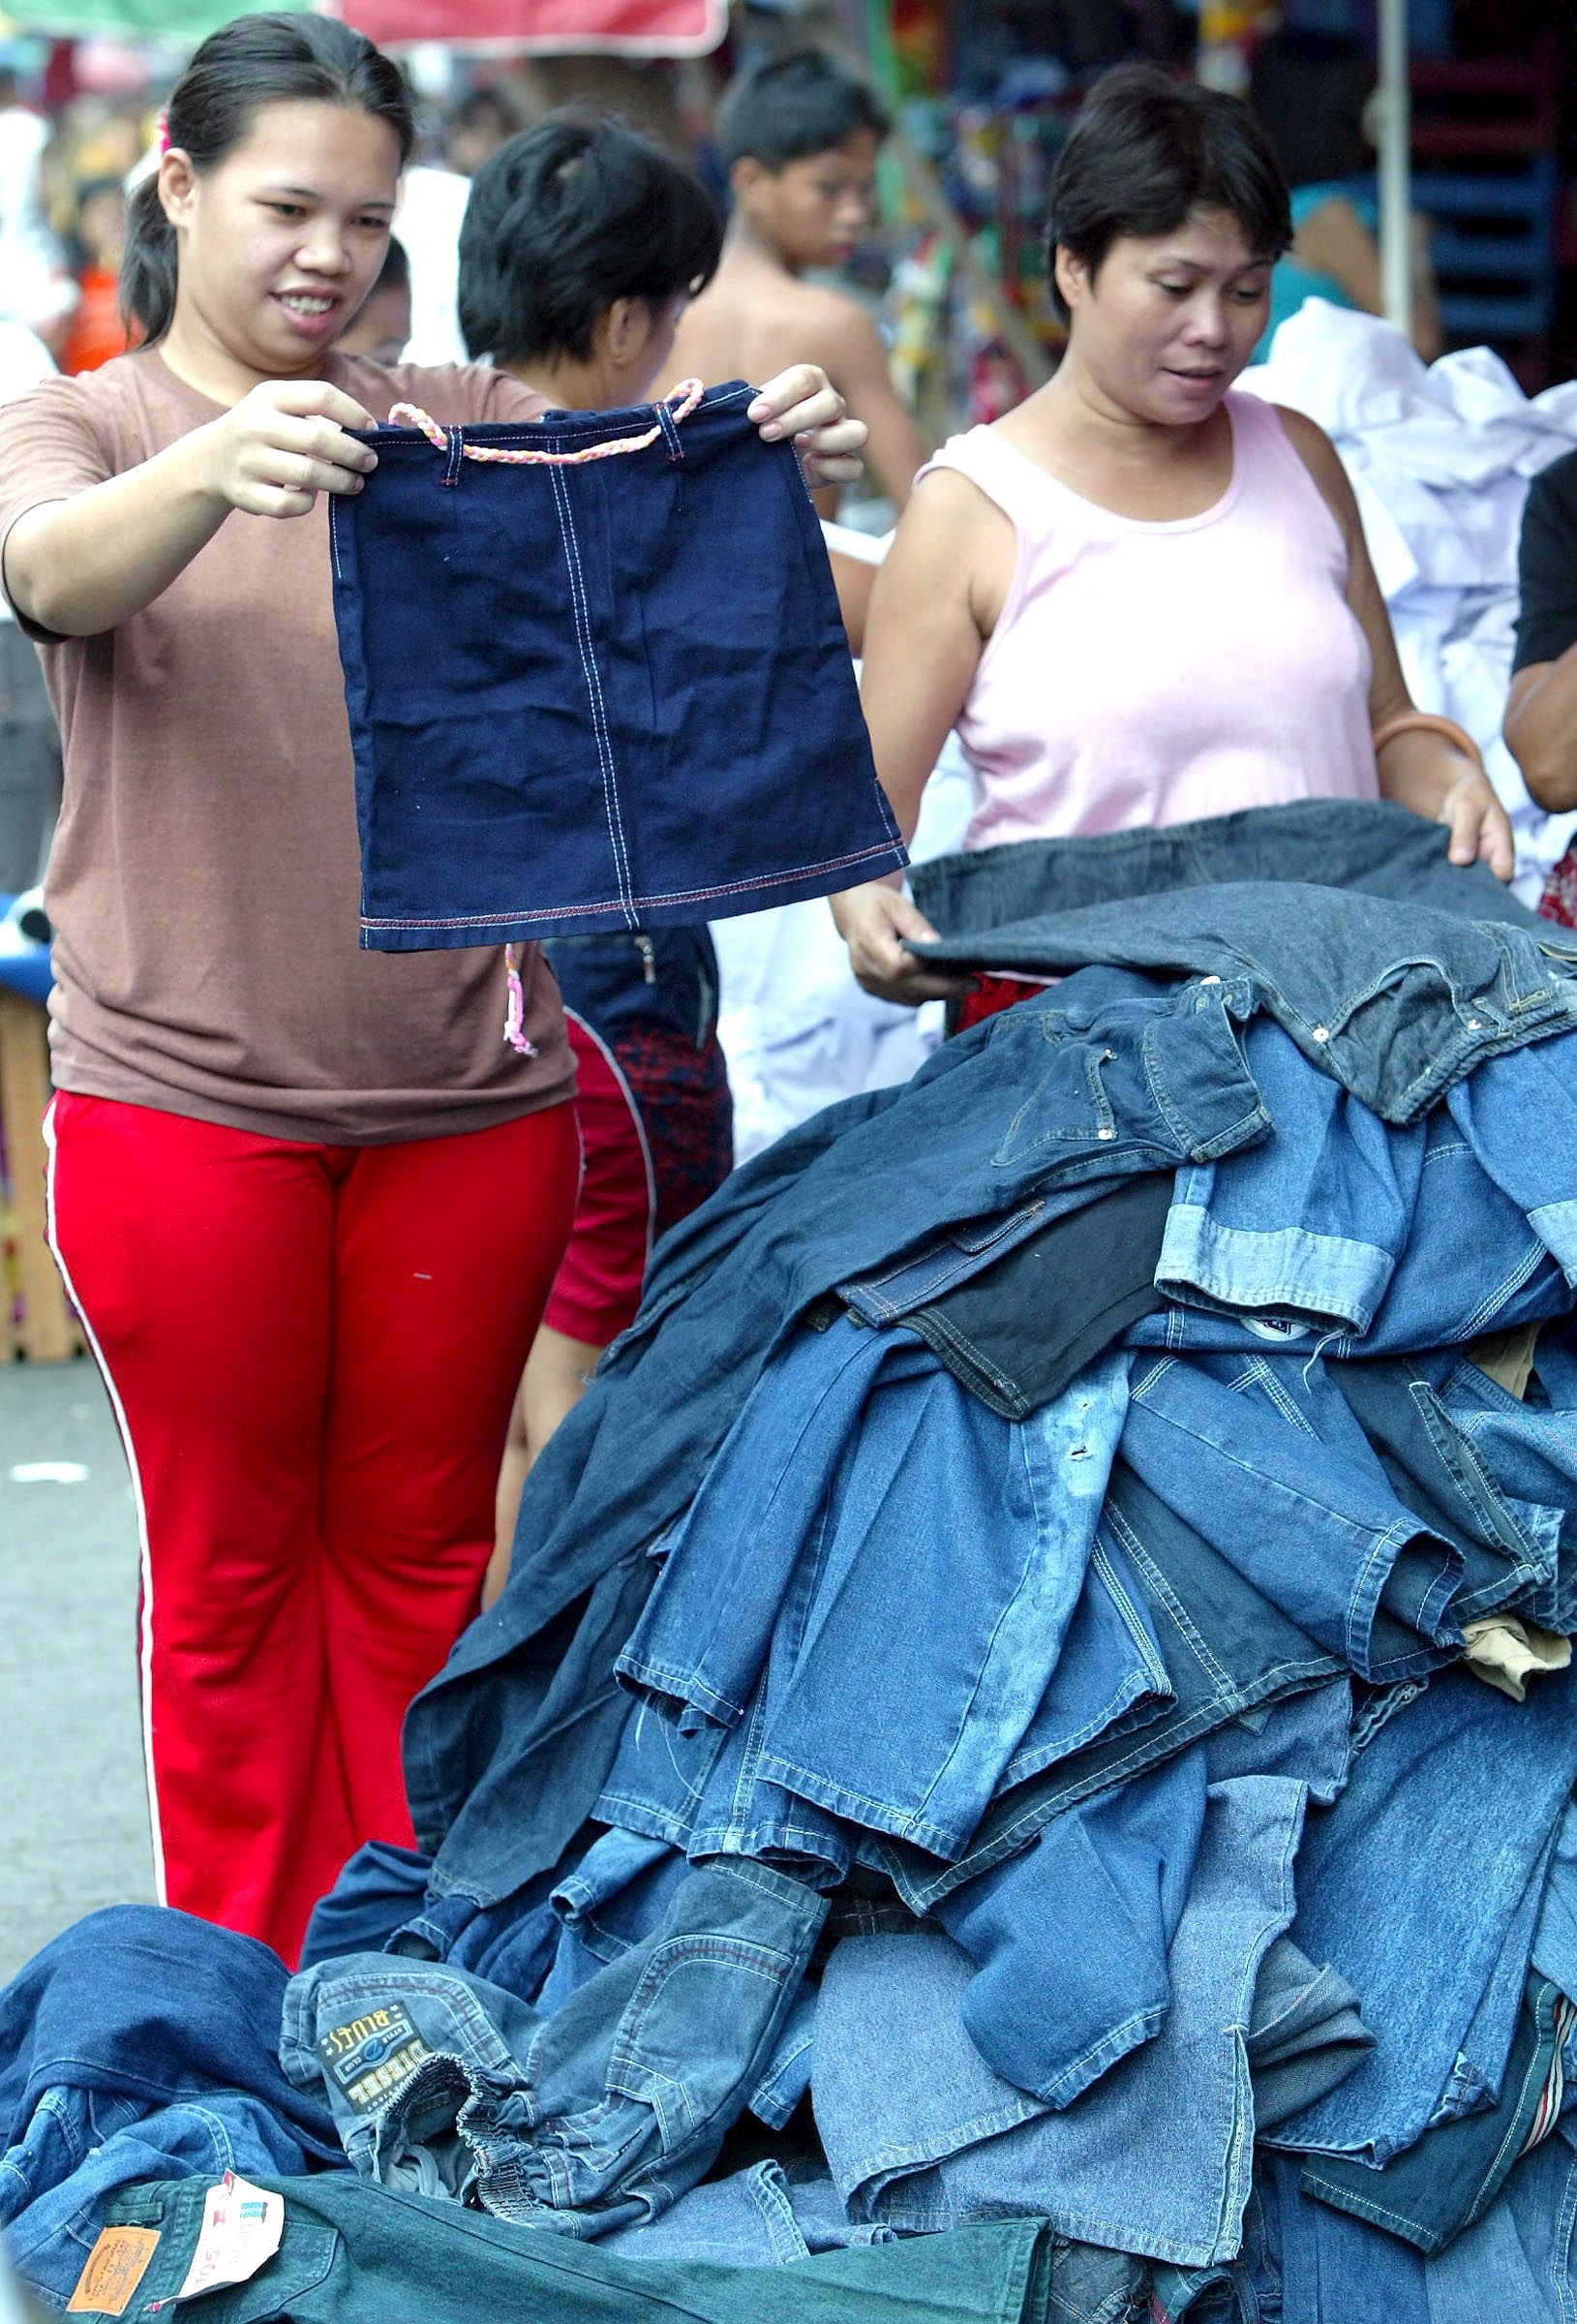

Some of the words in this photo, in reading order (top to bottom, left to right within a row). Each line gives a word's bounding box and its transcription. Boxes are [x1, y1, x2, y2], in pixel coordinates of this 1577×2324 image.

[329, 2009, 390, 2053] BLUES
[345, 2056, 362, 2072] CLUB
[349, 2039, 427, 2104] DIESEL
